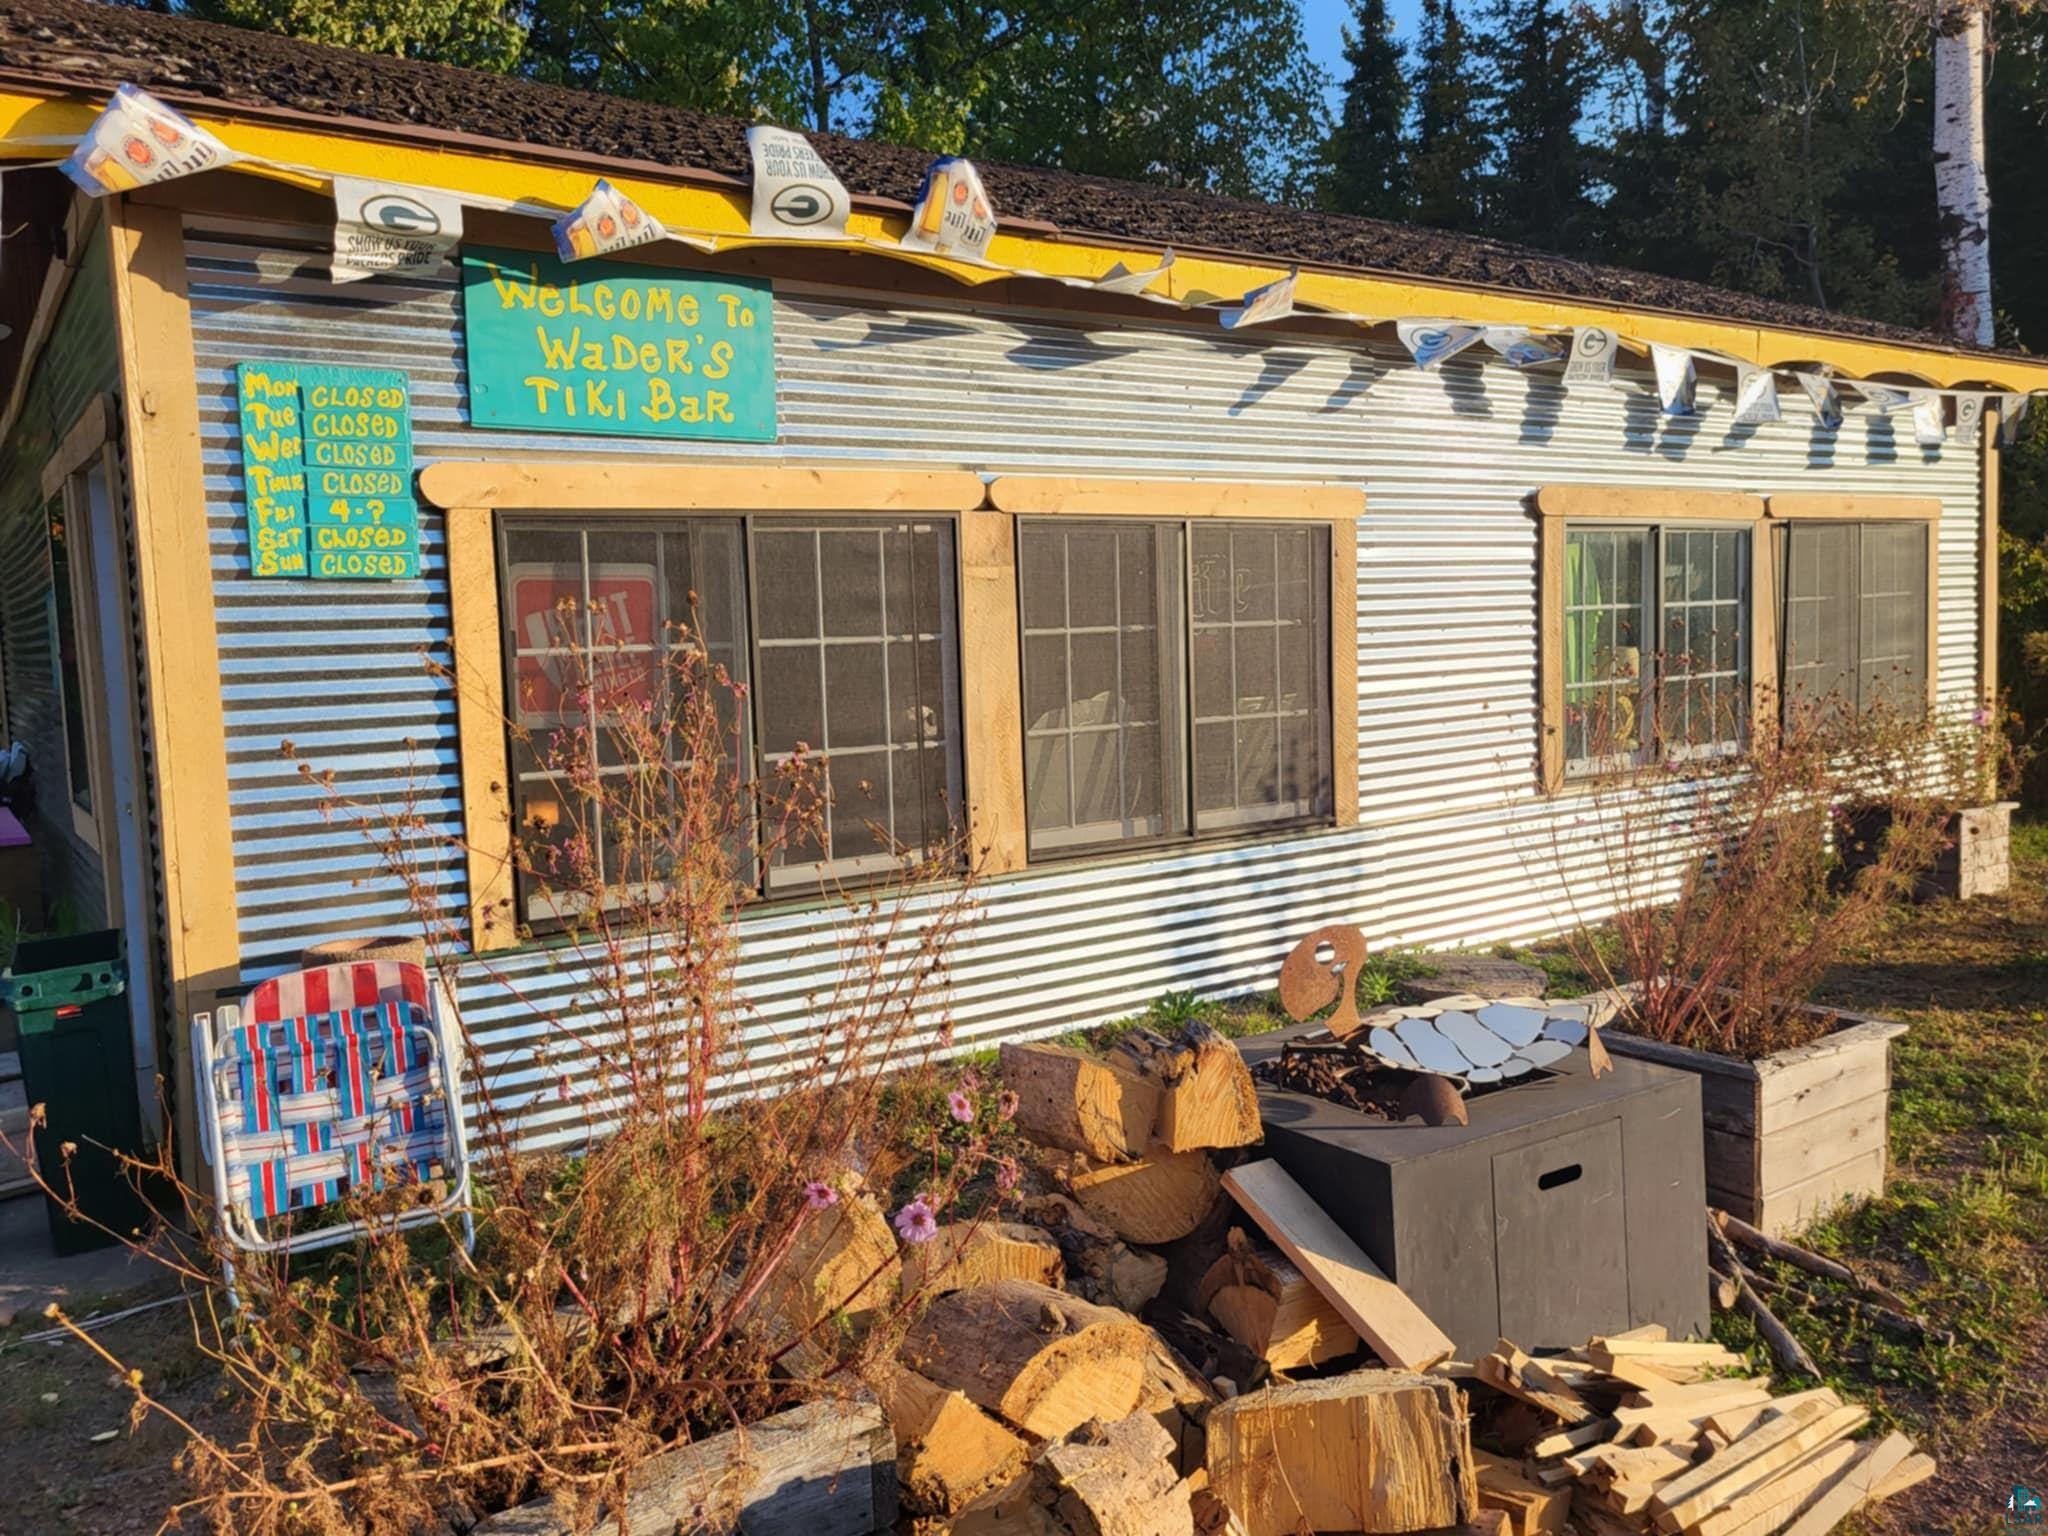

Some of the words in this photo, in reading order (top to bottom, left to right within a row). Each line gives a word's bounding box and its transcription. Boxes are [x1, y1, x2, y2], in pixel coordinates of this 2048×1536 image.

[762, 143, 792, 159] PRIDE
[766, 159, 793, 177] YOUR
[793, 160, 807, 178] US
[347, 235, 383, 253] SHOW
[384, 237, 401, 250] US
[398, 251, 432, 266] PRIDE
[485, 262, 699, 327] WeLCOMe
[717, 293, 755, 328] To
[536, 325, 735, 379] WaDeR'S
[311, 386, 404, 409] CLOSeD
[524, 376, 626, 421] TIKI
[641, 377, 735, 423] BaR
[312, 412, 399, 439] CLOSeD
[315, 442, 396, 467] CLOSeD
[322, 472, 403, 495] CLOSeD
[317, 527, 406, 549] CLOSeD
[320, 554, 406, 576] CLOSeD
